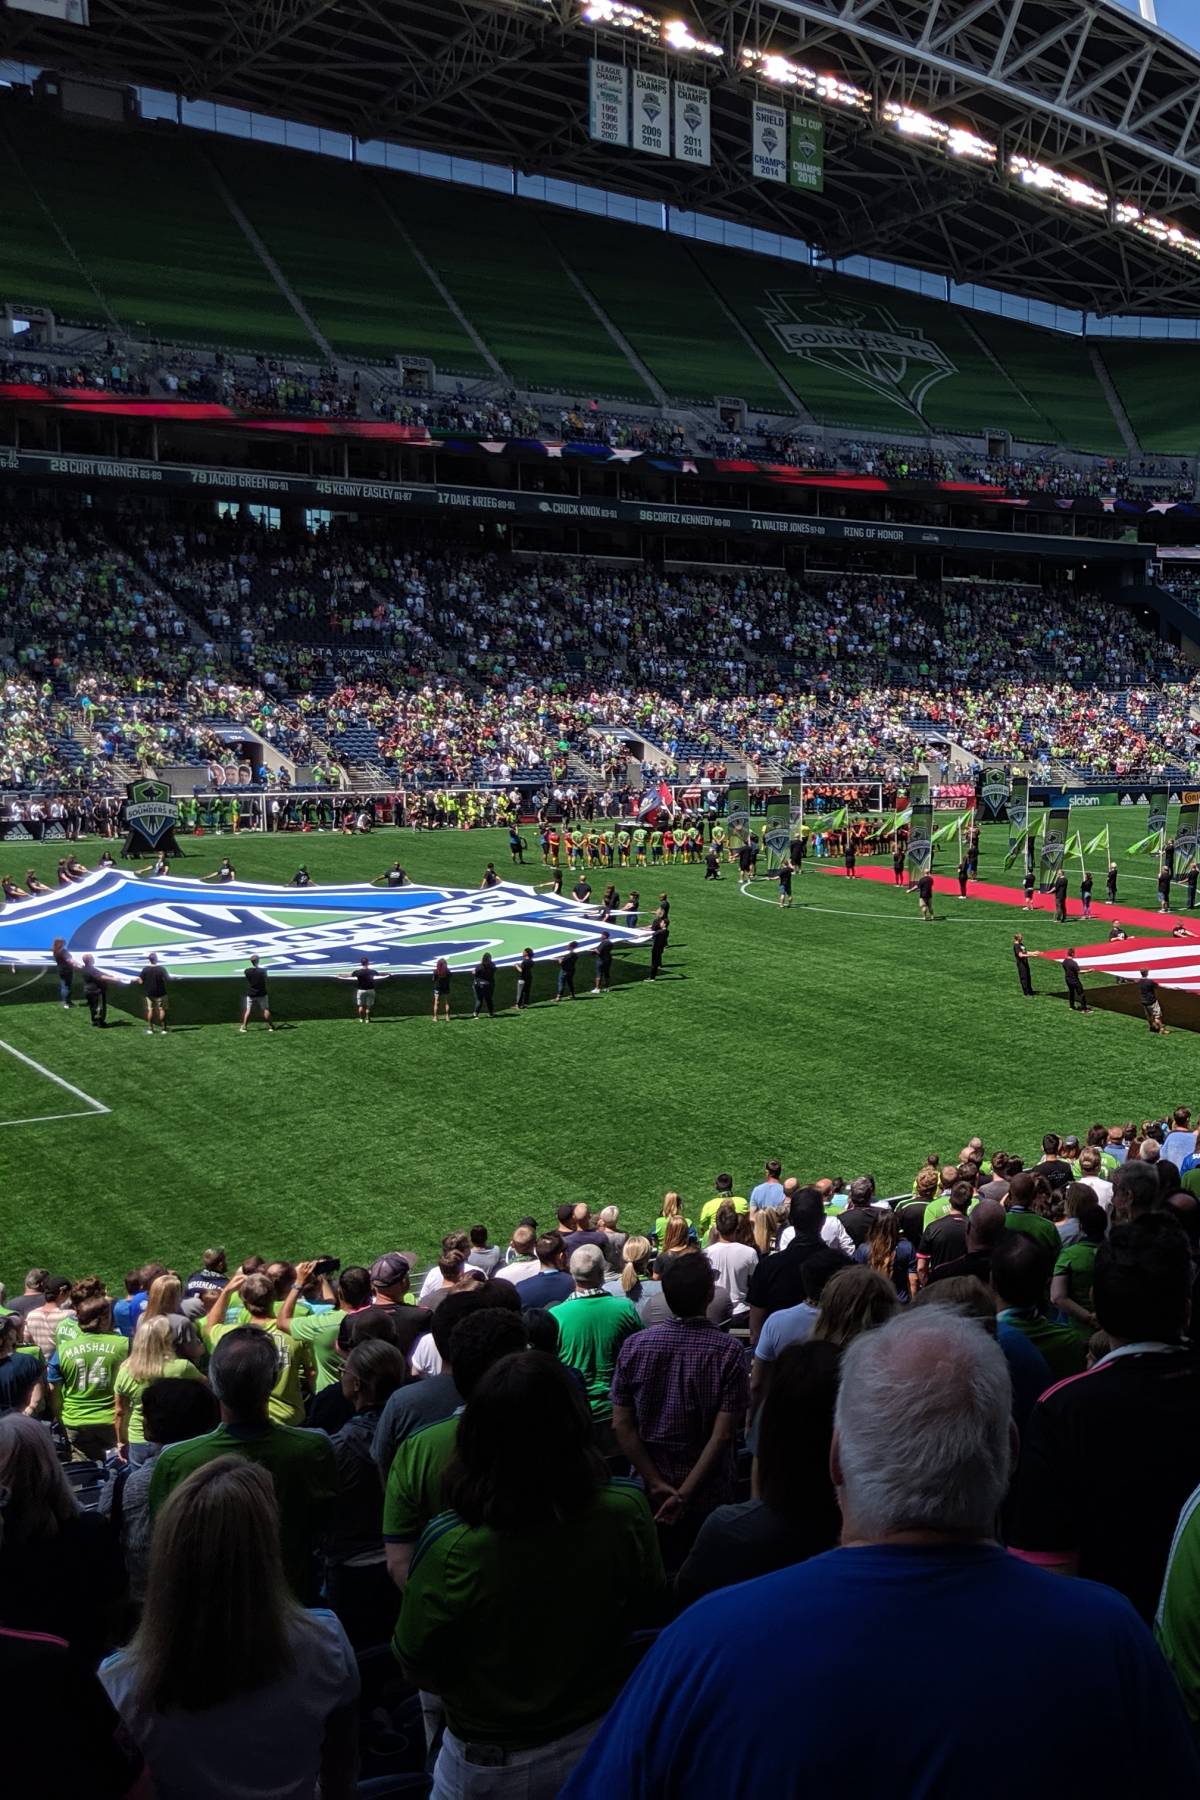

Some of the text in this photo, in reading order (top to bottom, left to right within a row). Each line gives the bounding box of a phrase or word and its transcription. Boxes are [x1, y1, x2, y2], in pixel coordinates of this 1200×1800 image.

[596, 72, 623, 85] CHAMPS
[637, 80, 667, 95] CHAMPS
[678, 91, 708, 105] CHAMPS
[756, 112, 784, 127] SHIELD
[808, 120, 822, 131] CUP
[601, 131, 618, 141] 2007
[642, 125, 662, 138] 2009
[642, 136, 662, 149] 2010
[684, 136, 702, 147] 2011
[684, 146, 703, 158] 2014
[754, 155, 785, 170] CHAMPS
[793, 161, 821, 177] CHAMPS
[761, 166, 779, 177] 2014
[798, 172, 817, 185] 2016
[13, 305, 45, 317] 334
[789, 333, 903, 352] SOUNDERS
[908, 346, 941, 362] FC
[50, 460, 68, 472] 28
[70, 462, 95, 475] CURT
[97, 464, 140, 480] WARNER
[191, 471, 207, 484] 79
[208, 472, 238, 487] JACOB
[239, 475, 268, 490] GREEN
[316, 483, 331, 495] 45
[332, 485, 362, 498] KENNY
[363, 487, 393, 501] EASLEY
[438, 493, 449, 504] 17
[450, 494, 472, 506] DAVE
[473, 495, 498, 508] KRIEG
[553, 503, 578, 514] CHUCK
[580, 505, 601, 517] KNOX
[640, 510, 653, 521] 96
[654, 511, 680, 524] CORTEZ
[681, 514, 714, 526] KENNEDY
[752, 519, 762, 530] 71
[762, 520, 788, 533] WALTER
[789, 522, 810, 534] JONES
[844, 525, 905, 541] RING OF HONOR
[1069, 794, 1100, 806] slalom
[128, 806, 167, 818] SOUNDERS
[4, 833, 34, 841] adidas
[98, 894, 518, 964] SOUNDERS
[65, 1343, 116, 1358] MARSHALL
[75, 1356, 107, 1392] 14
